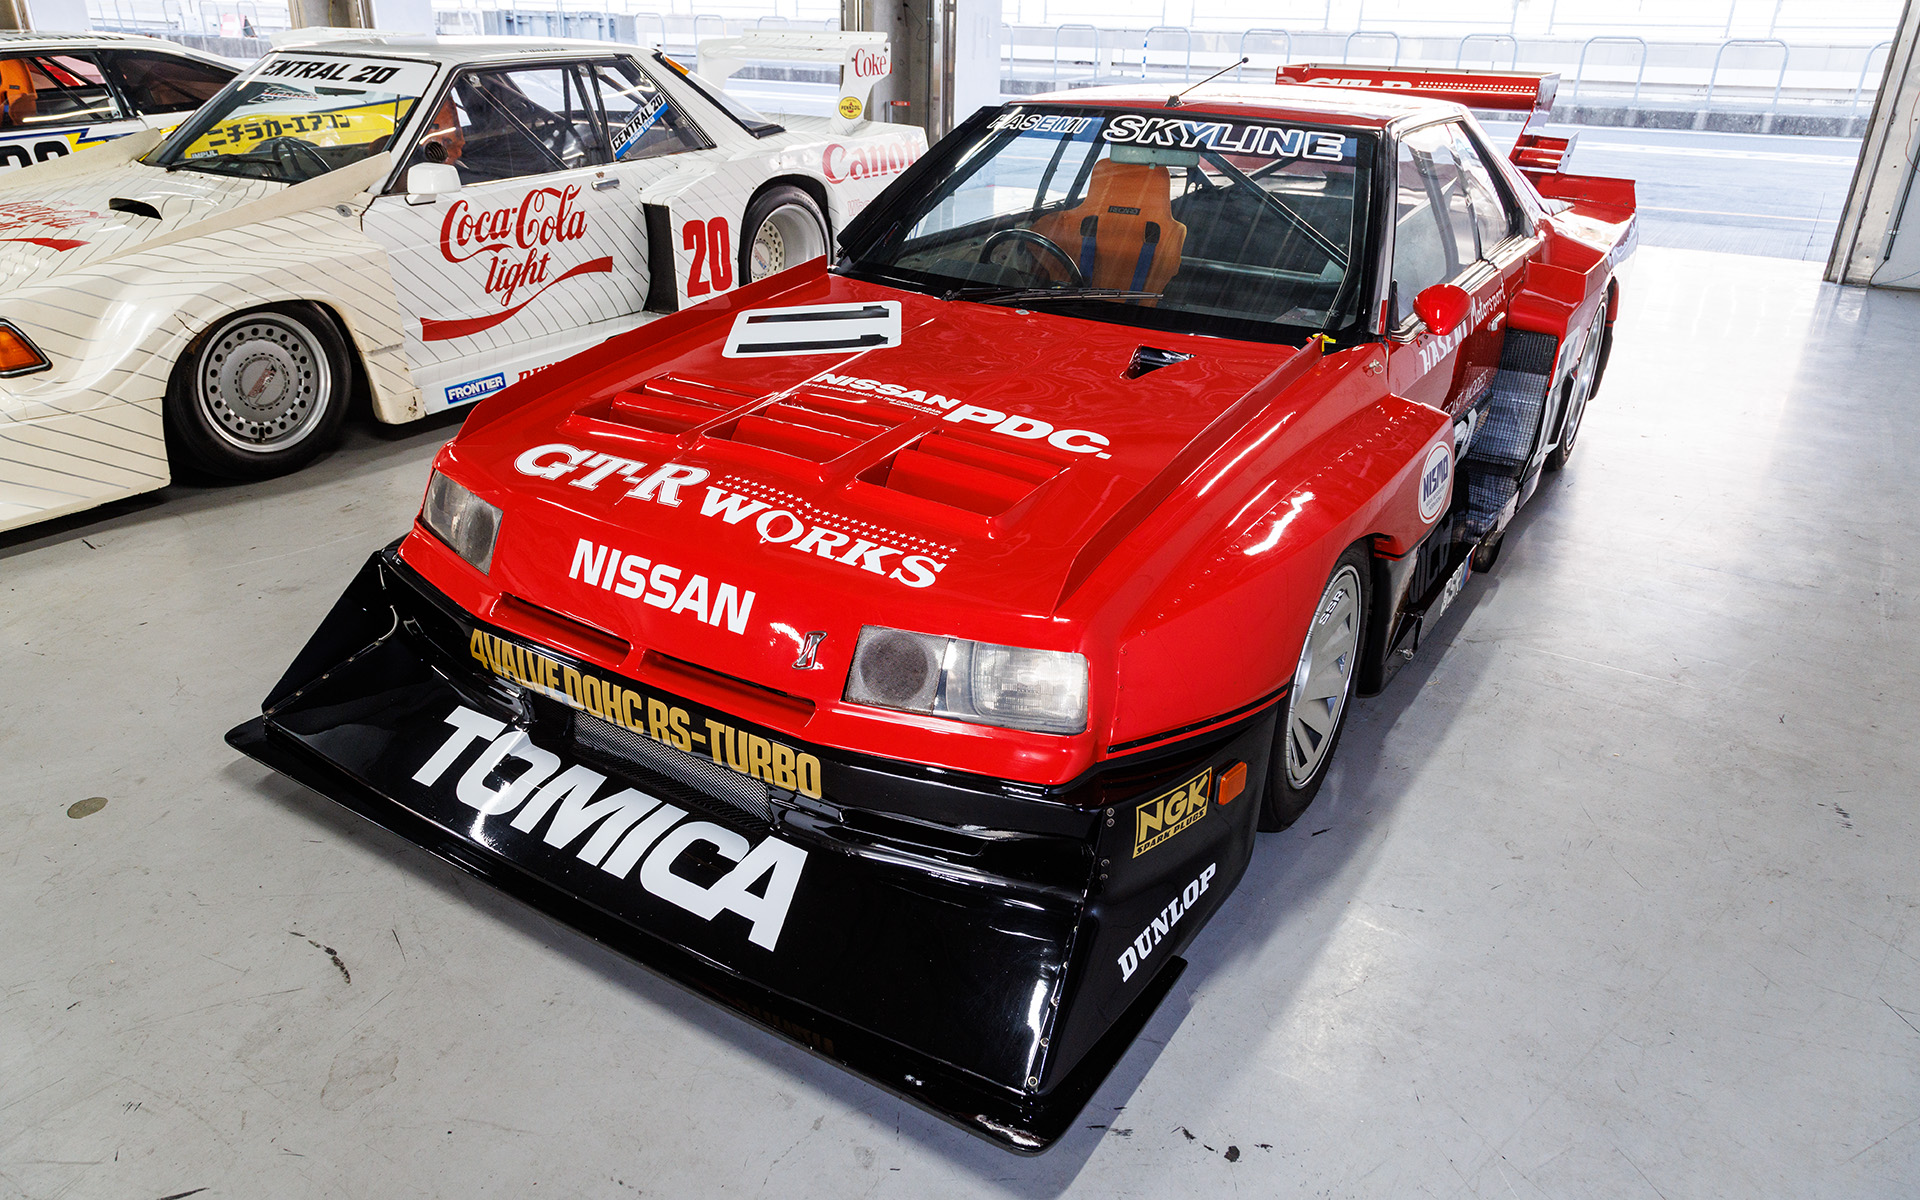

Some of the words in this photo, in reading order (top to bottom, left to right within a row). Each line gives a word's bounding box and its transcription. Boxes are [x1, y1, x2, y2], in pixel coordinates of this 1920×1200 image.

[261, 60, 351, 81] ENTRAL
[348, 65, 402, 84] 20
[855, 48, 887, 77] Coke
[612, 107, 653, 151] CENTRAL
[650, 94, 663, 112] 20
[986, 114, 1092, 134] HASEMI
[1103, 115, 1346, 162] SKYLINE
[822, 138, 922, 184] Canon
[440, 184, 588, 263] Coca-Cola
[485, 247, 551, 307] light
[683, 216, 733, 298] 20
[1469, 281, 1506, 336] Motorsport
[447, 376, 505, 400] FRONTIER
[812, 372, 962, 411] NISSAN
[942, 404, 1112, 460] PDC.
[1423, 453, 1449, 502] NISMO
[514, 443, 710, 507] GT-R
[700, 486, 948, 588] WORKS
[568, 538, 756, 635] NISSAN
[1318, 588, 1346, 626] SSR
[563, 665, 645, 735] DOHC
[648, 697, 822, 800] RS-TURBO
[411, 705, 809, 952] TOMICA
[1136, 829, 1172, 856] SPARK
[1173, 807, 1207, 837] PLUGS
[1138, 773, 1209, 845] NGK
[1117, 862, 1217, 984] DUNLOP
